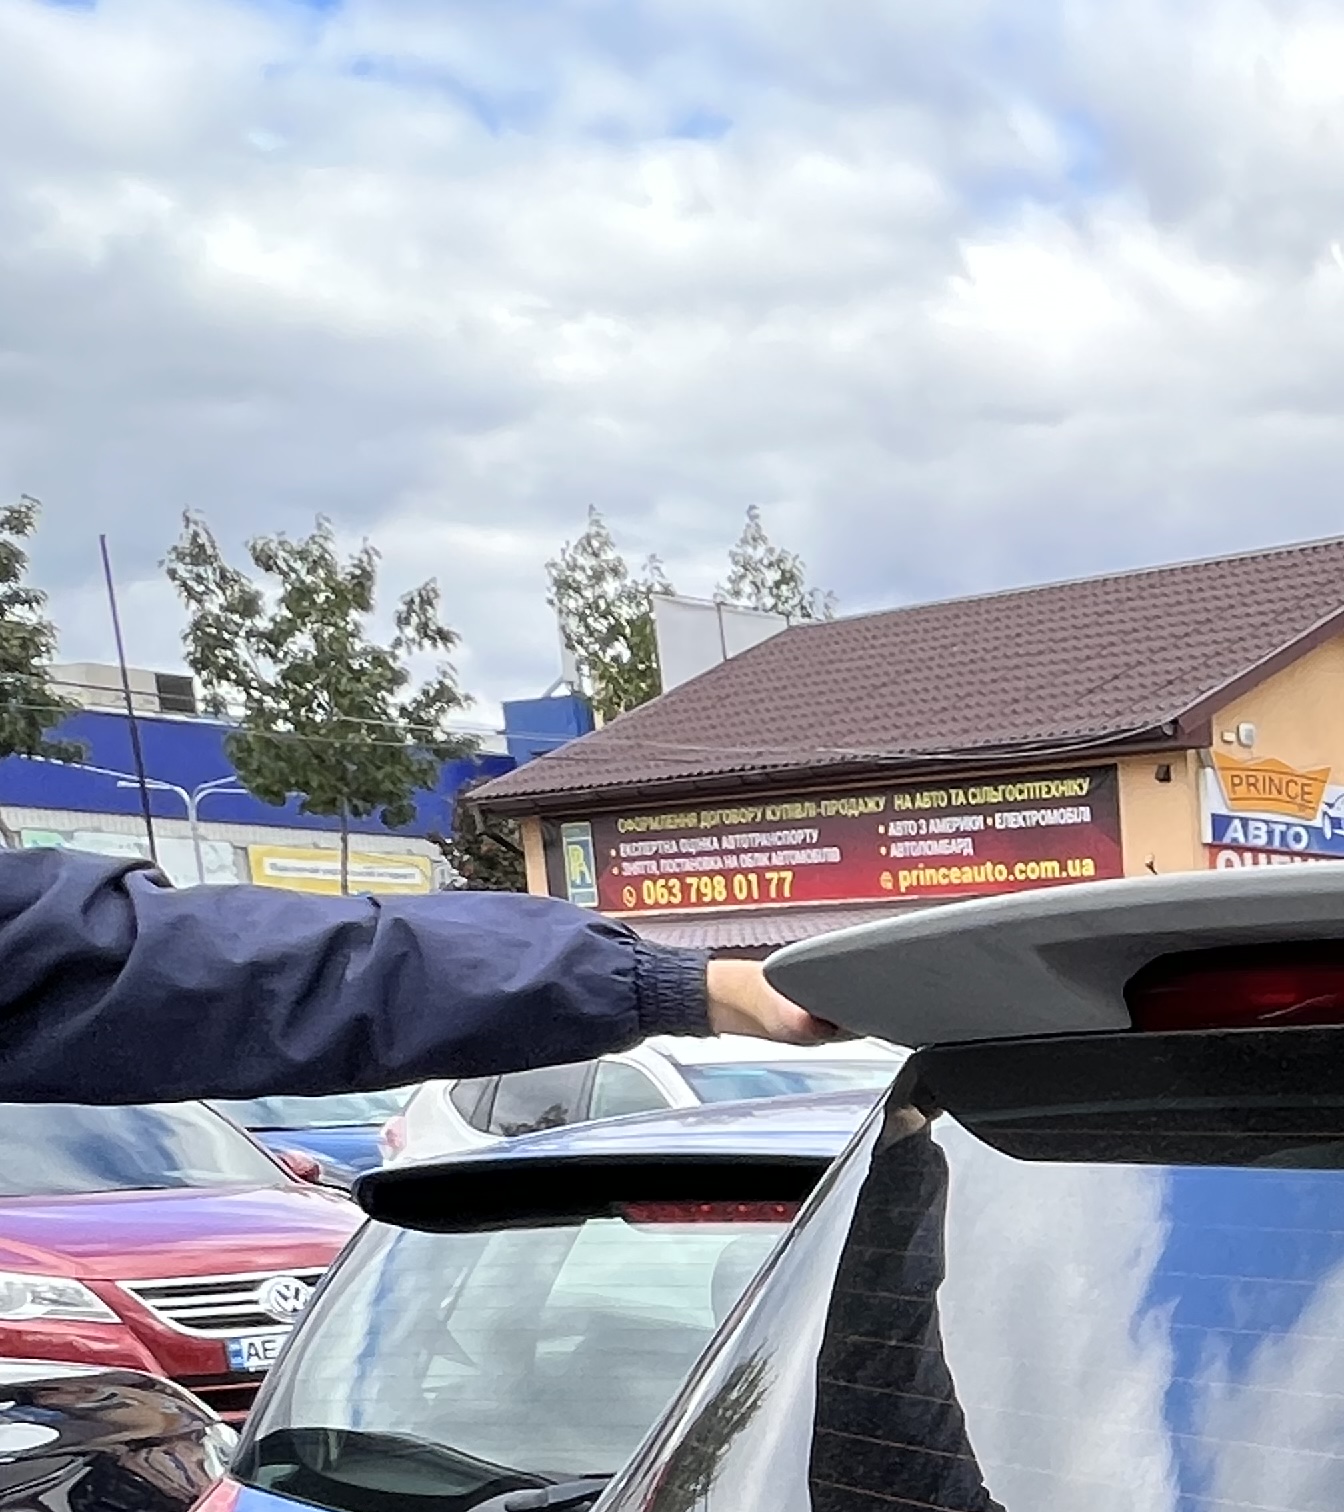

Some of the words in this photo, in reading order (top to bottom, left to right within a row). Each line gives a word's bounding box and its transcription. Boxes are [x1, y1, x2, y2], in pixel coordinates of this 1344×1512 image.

[894, 794, 914, 811] НА
[914, 790, 947, 809] АВТО
[949, 788, 967, 806] ТА
[1230, 774, 1313, 803] PRINCE
[1222, 818, 1310, 850] АВТО
[642, 878, 681, 904] 063
[686, 875, 727, 901] 798
[733, 873, 759, 899] 01
[765, 870, 793, 898] 77
[898, 857, 1096, 893] princeauto.com.ua
